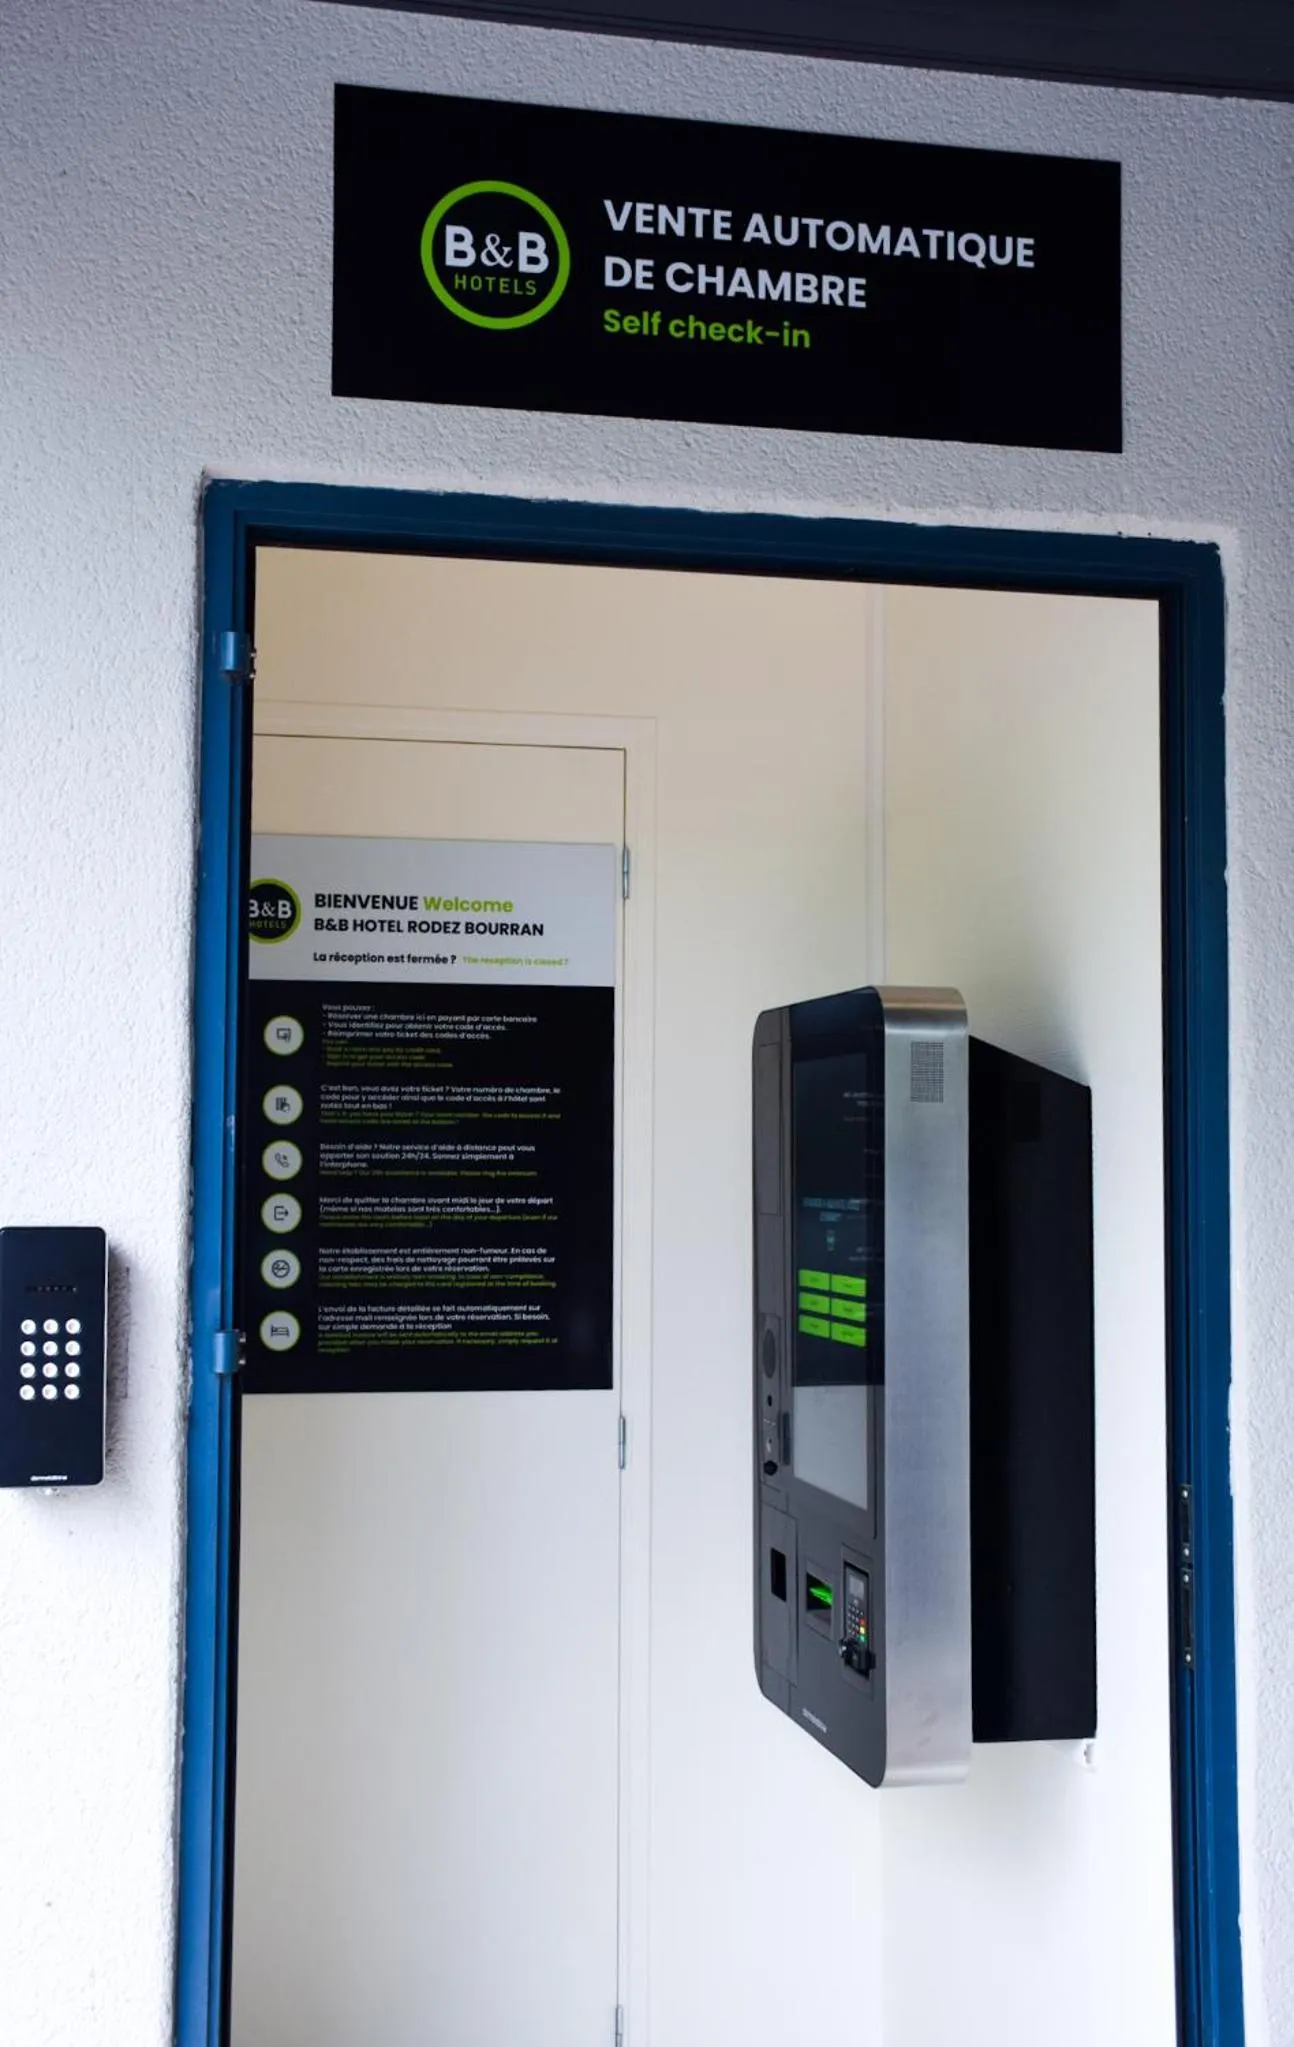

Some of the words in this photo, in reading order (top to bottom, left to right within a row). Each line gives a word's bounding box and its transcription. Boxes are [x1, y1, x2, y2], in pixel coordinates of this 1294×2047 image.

[603, 199, 733, 242] VENTE
[742, 212, 1036, 270] AUTOMATIQUE
[443, 224, 550, 273] B&B
[453, 272, 539, 297] HOTELS
[603, 256, 655, 291] DE
[664, 262, 868, 309] CHAMBRE
[603, 308, 662, 338] Self
[667, 313, 812, 349] check-in
[314, 893, 420, 911] BIENVENUE
[423, 895, 514, 914] Welcome
[250, 919, 287, 929] HOTELS
[314, 918, 349, 932] B&B
[353, 919, 404, 934] HOTEL
[408, 920, 461, 935] RODEZ
[465, 921, 544, 937] BOURRAN
[313, 952, 327, 963] La
[329, 952, 385, 966] réception
[387, 954, 405, 964] est
[407, 952, 449, 965] fermée
